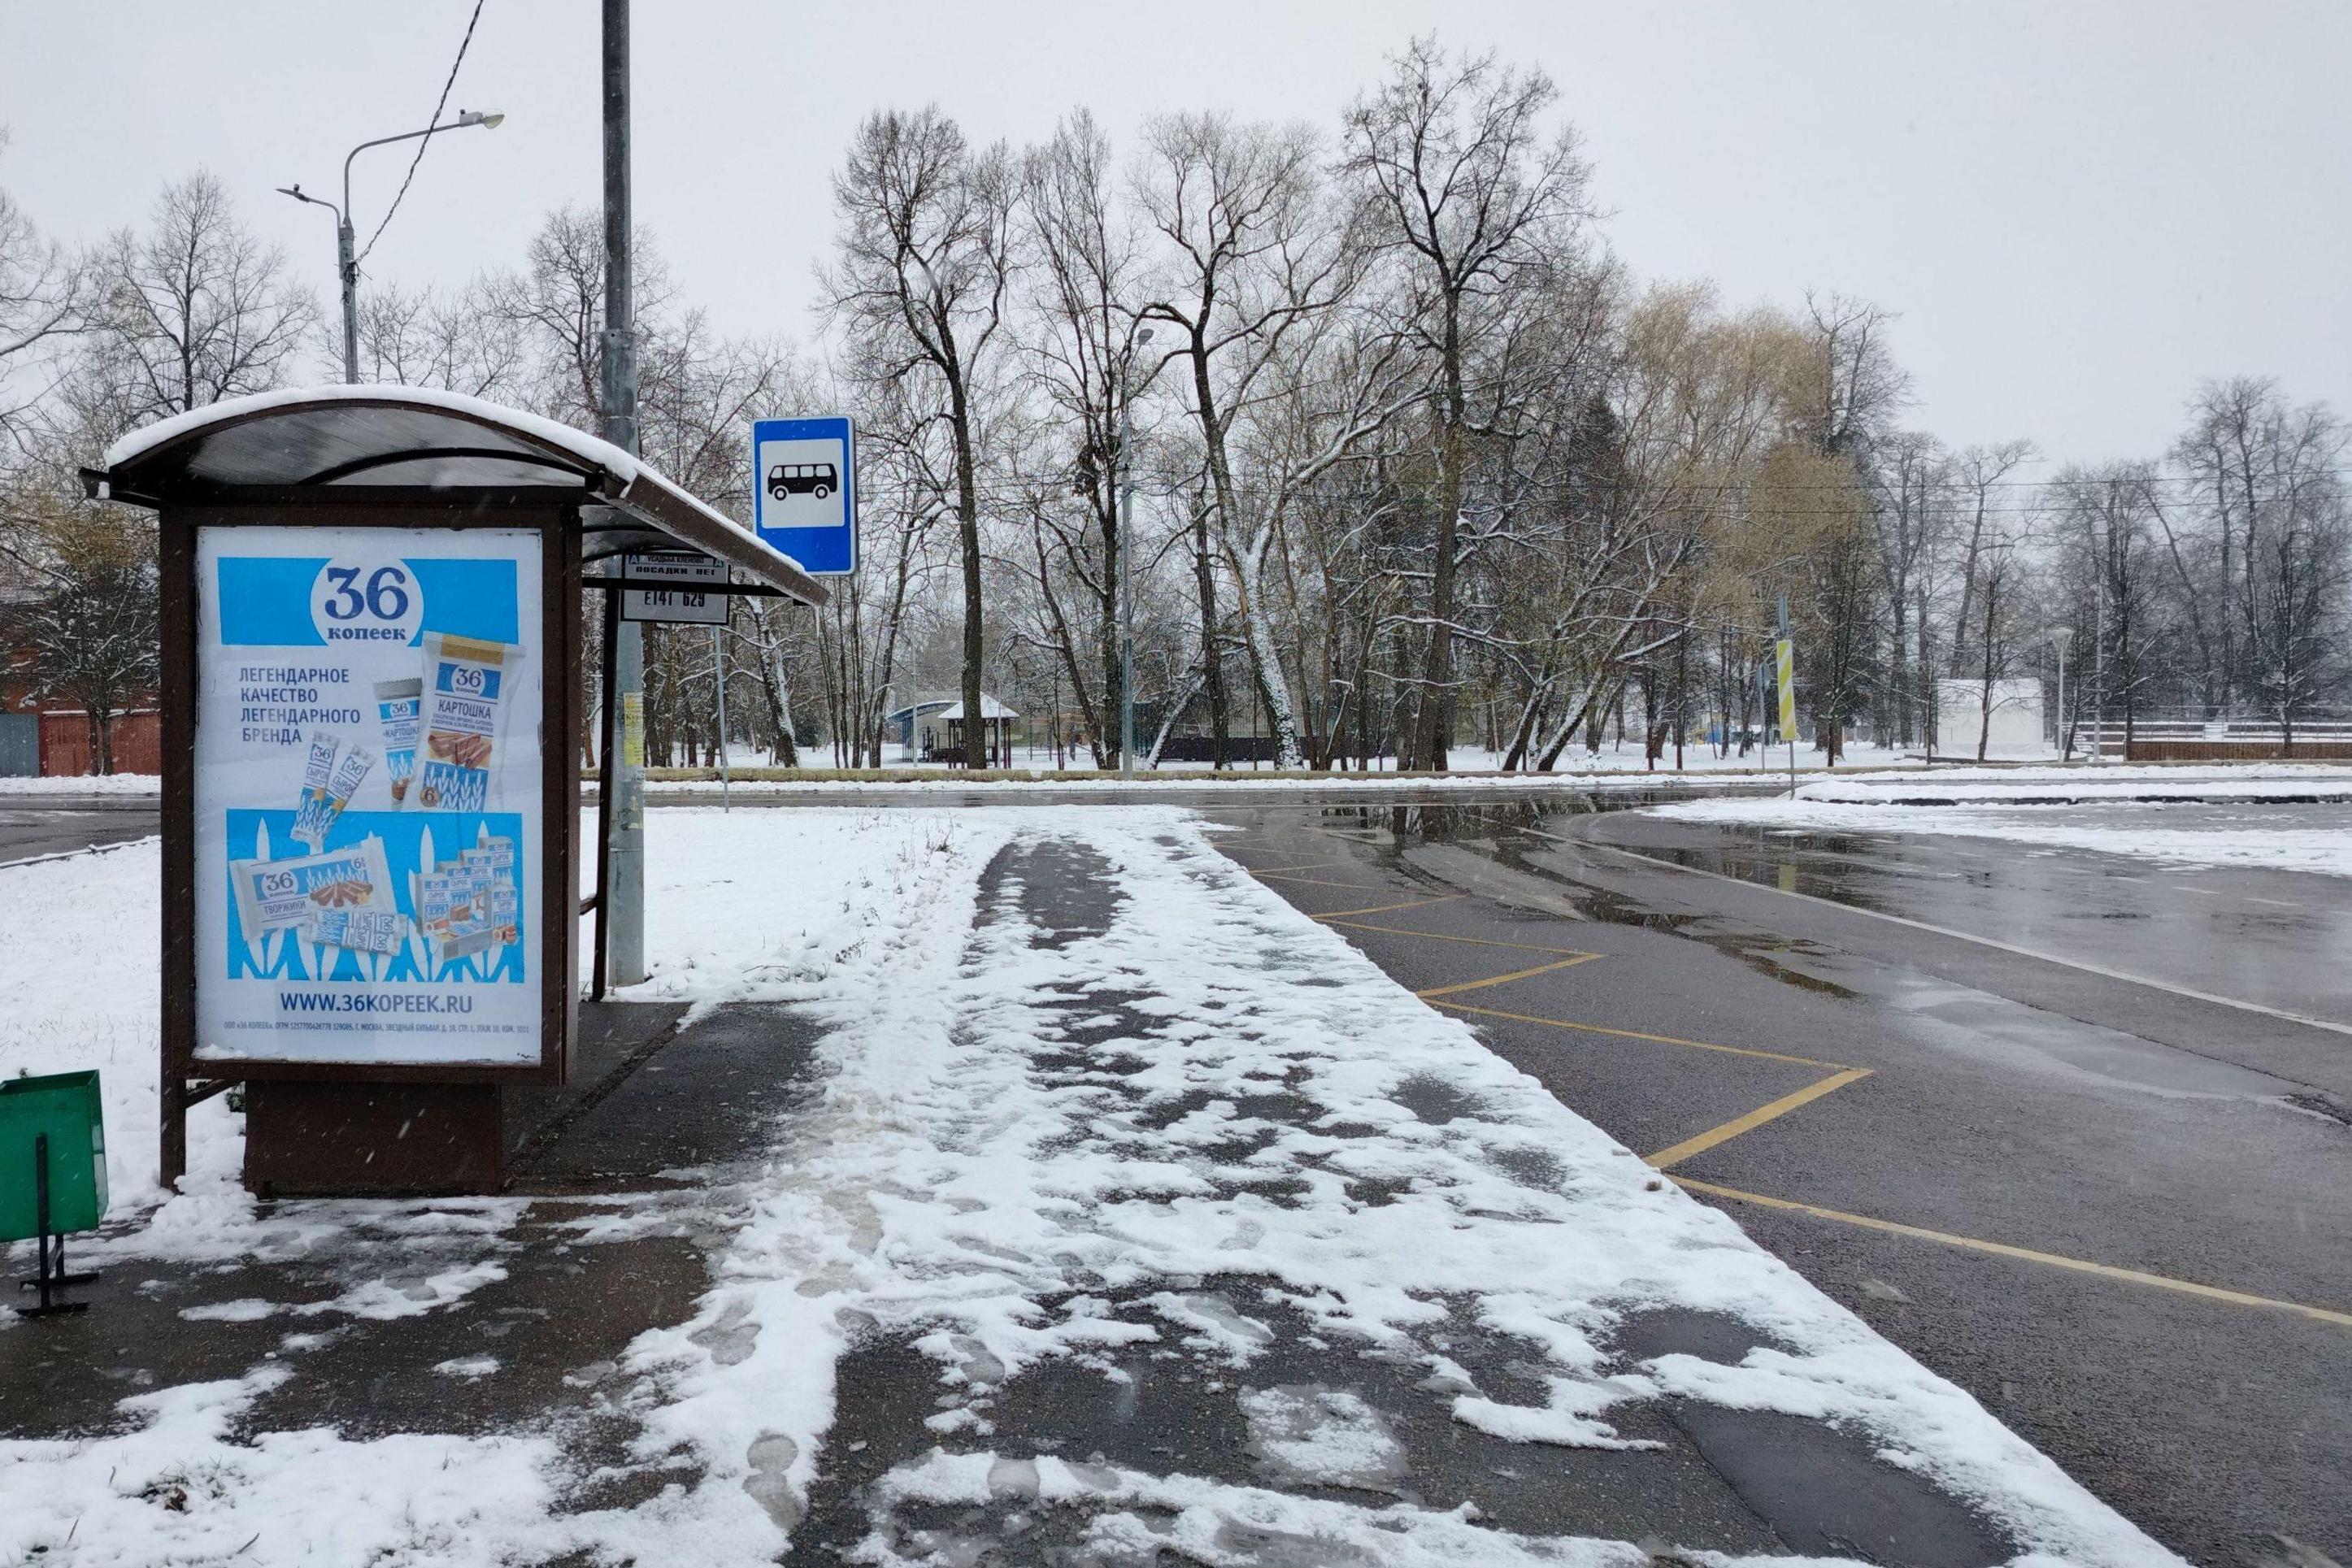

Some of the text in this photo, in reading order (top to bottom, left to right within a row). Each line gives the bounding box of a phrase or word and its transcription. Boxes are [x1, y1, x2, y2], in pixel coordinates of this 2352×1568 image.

[636, 567, 688, 575] ПОСАДКИ
[325, 567, 408, 620] 36
[683, 592, 705, 607] 629
[328, 627, 406, 641] копеек
[239, 667, 350, 685] ЛЕГЕНДАРНОЕ
[456, 667, 481, 688] 36
[241, 688, 318, 703] КАЧЕСТВО
[392, 702, 408, 715] 36
[439, 699, 491, 719] КАРТОШКА
[241, 708, 360, 725] ЛЕГЕНДАРНОГО
[242, 728, 302, 745] БРЕНДА
[314, 745, 332, 760] 36
[347, 759, 364, 775] 36
[424, 788, 435, 801] 6
[354, 858, 362, 870] 6
[266, 871, 294, 892] 36
[280, 992, 472, 1014] WWW.36KOPEEK.RU
[224, 1021, 236, 1030] ООО
[275, 1021, 289, 1030] ОГРН
